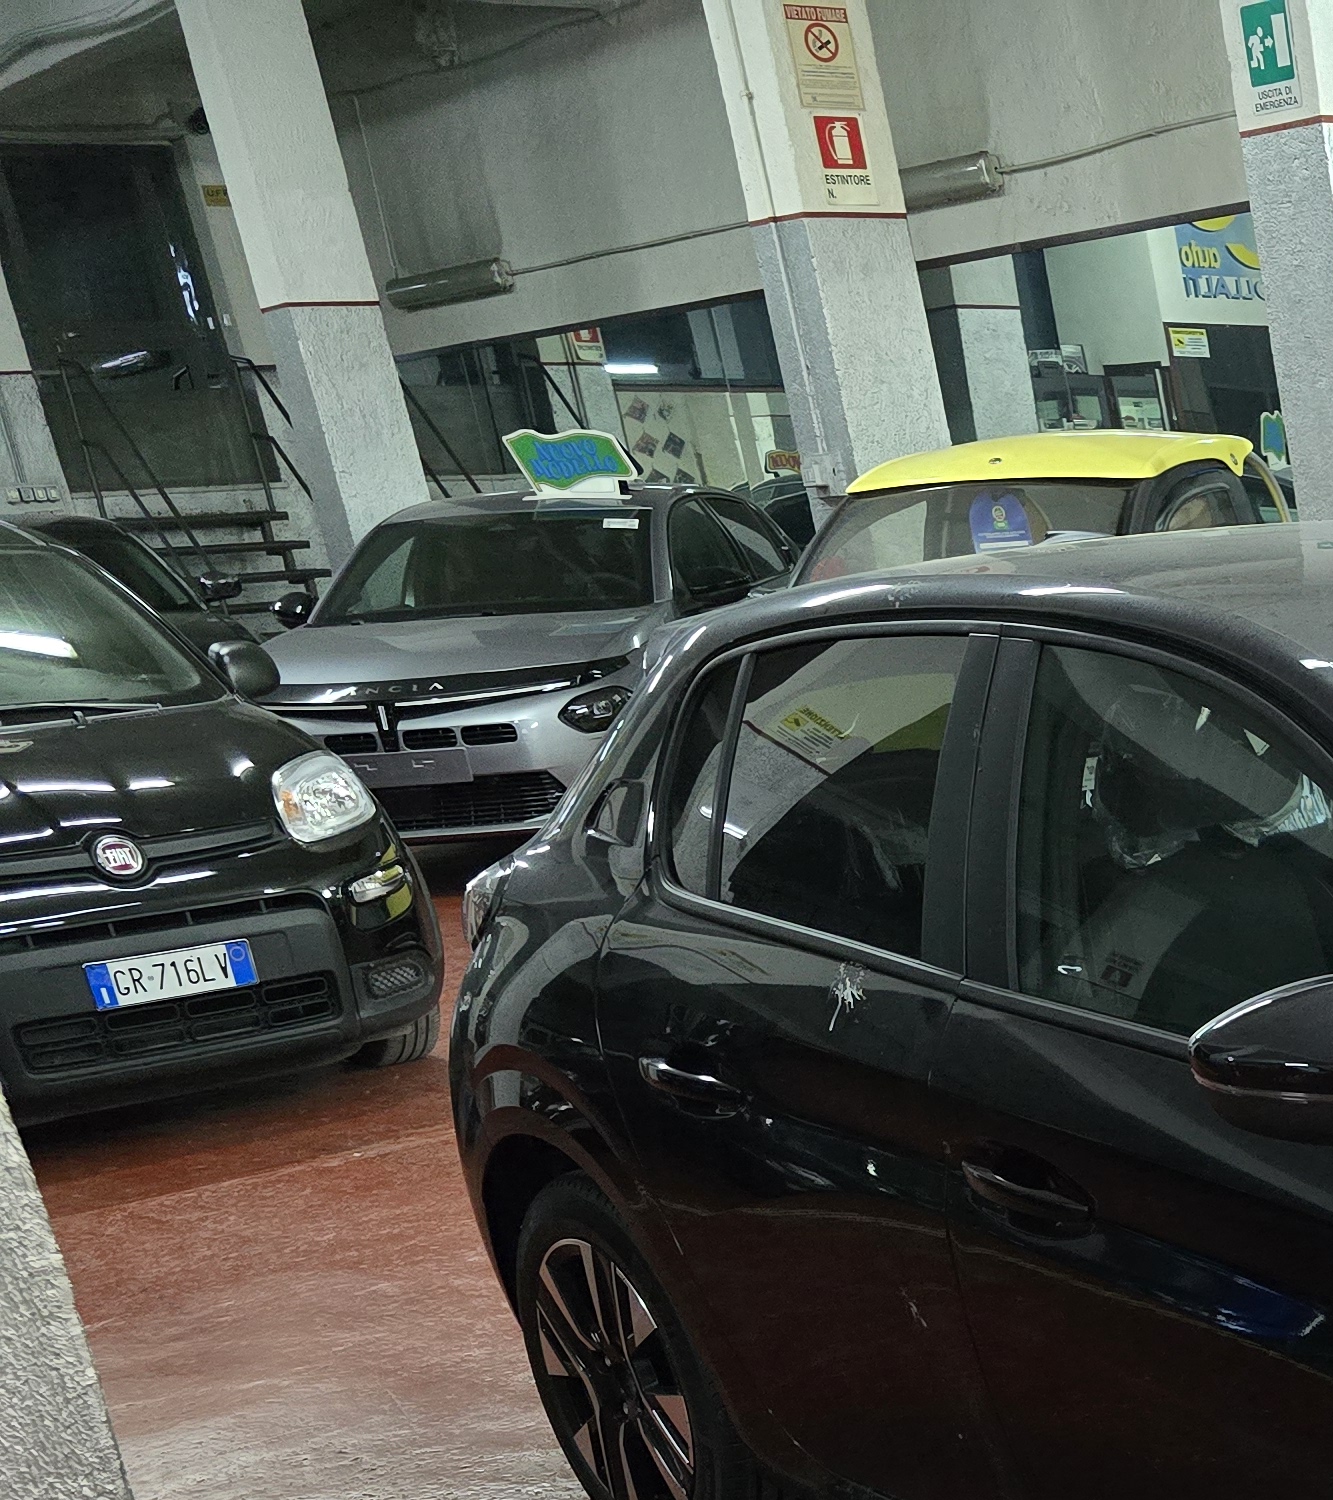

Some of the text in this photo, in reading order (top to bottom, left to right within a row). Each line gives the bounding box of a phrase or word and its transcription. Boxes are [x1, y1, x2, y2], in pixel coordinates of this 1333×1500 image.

[785, 5, 847, 22] VIETATO FUMARE
[1257, 86, 1293, 101] USCITA DI
[1255, 96, 1299, 112] EMERGENZA
[824, 174, 871, 186] ESTINTORE
[827, 188, 837, 199] N.
[533, 438, 597, 461] NUOVO
[530, 455, 618, 480] MODELLO
[104, 847, 138, 869] FIAT
[113, 952, 229, 996] GR 716LV
